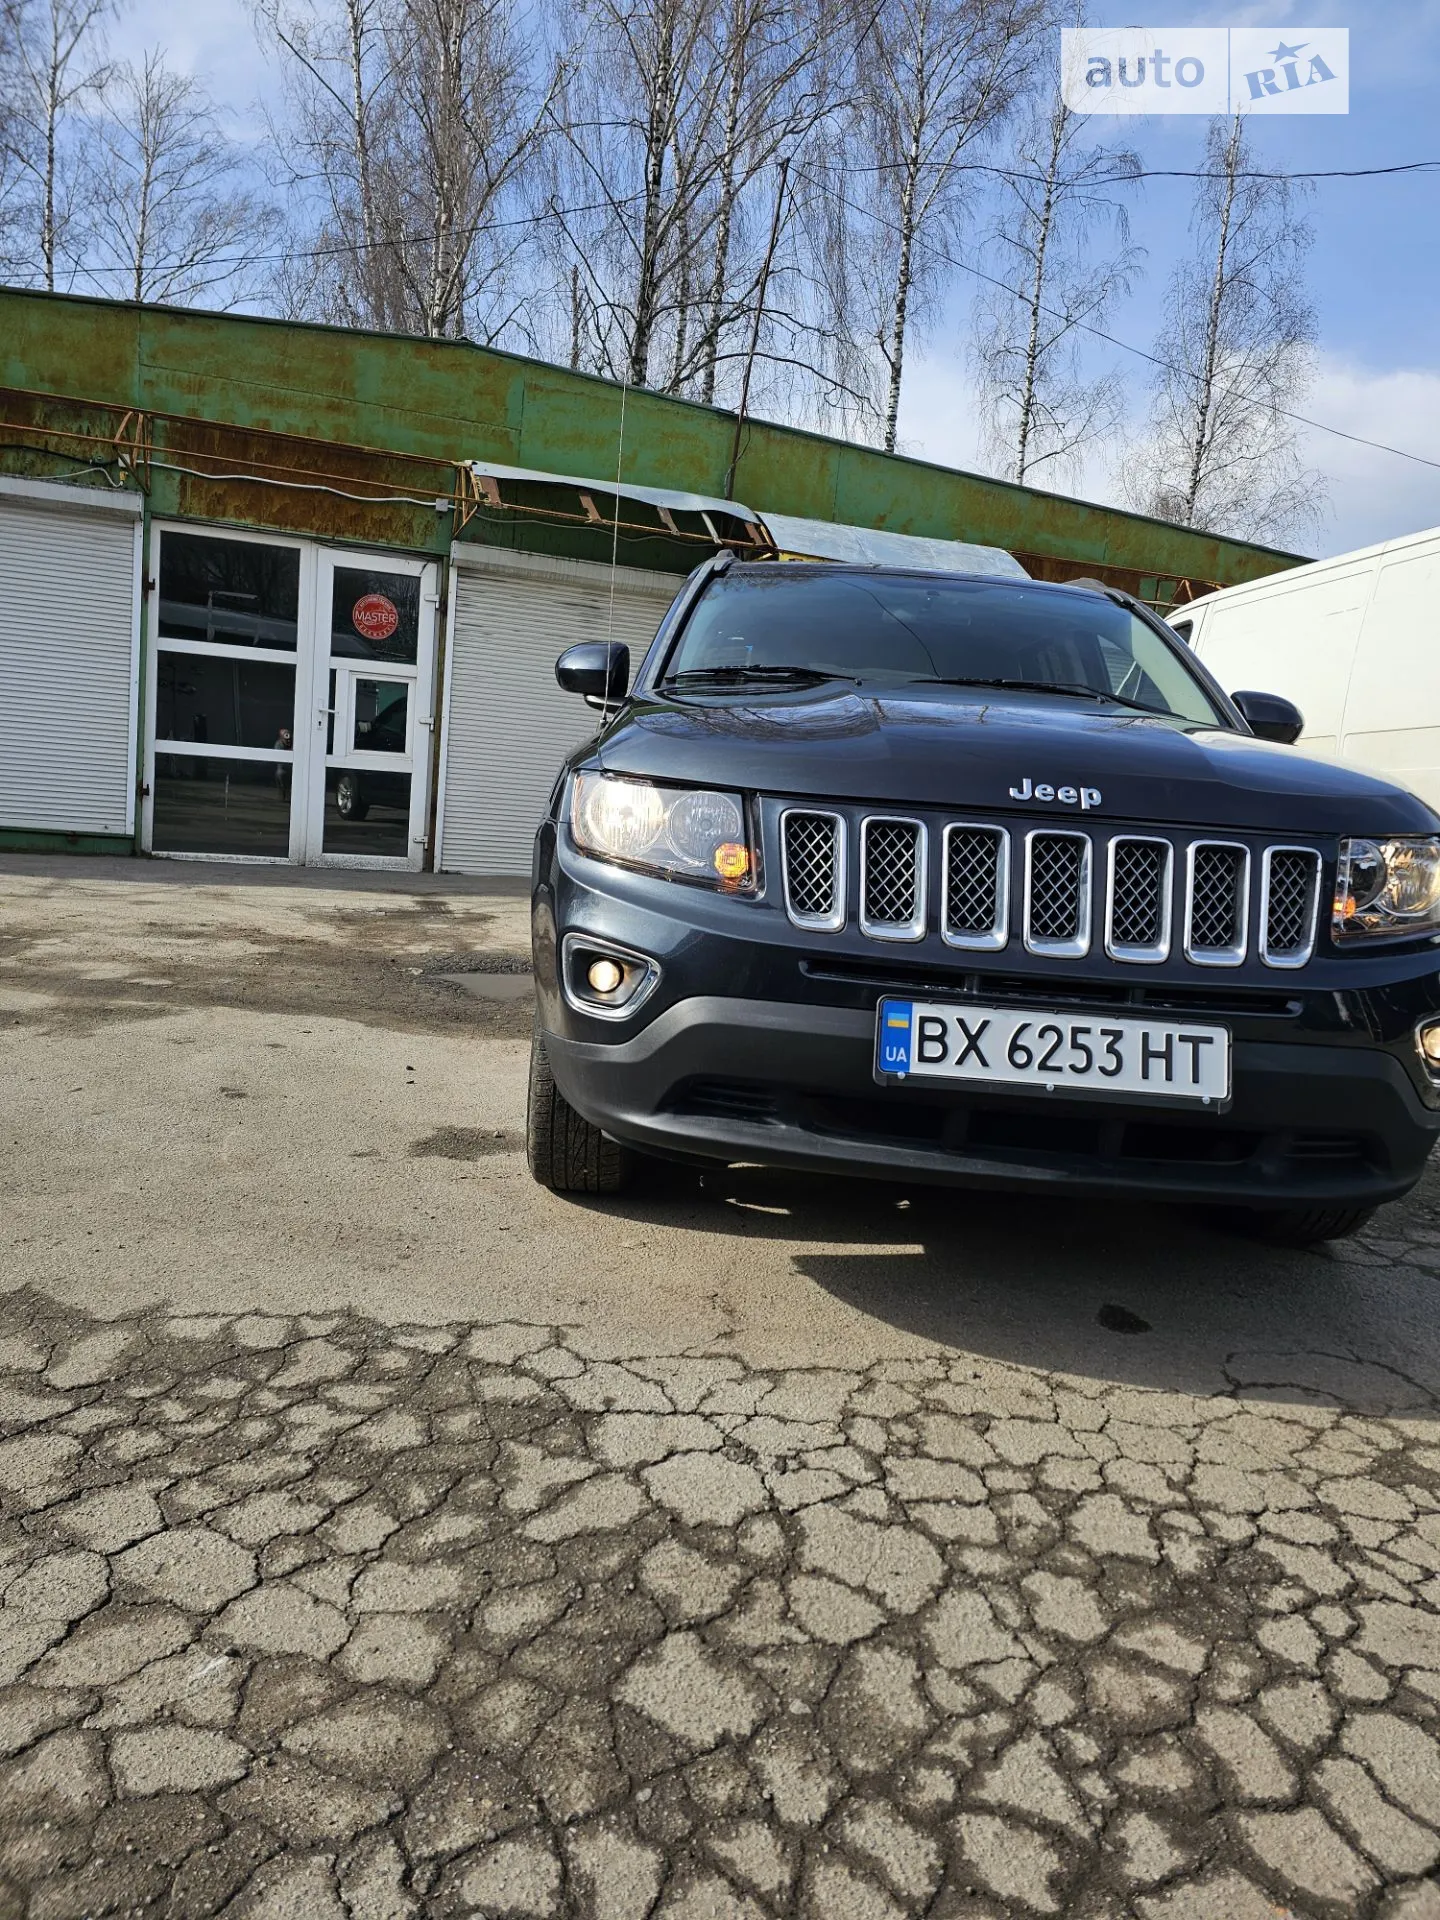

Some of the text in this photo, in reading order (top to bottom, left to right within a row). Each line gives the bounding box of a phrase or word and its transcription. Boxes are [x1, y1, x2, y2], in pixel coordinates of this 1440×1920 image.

[355, 610, 396, 623] MASTER
[1009, 778, 1102, 810] Jeep
[885, 1045, 907, 1063] UA
[916, 1015, 1214, 1084] BX 6253 HT
